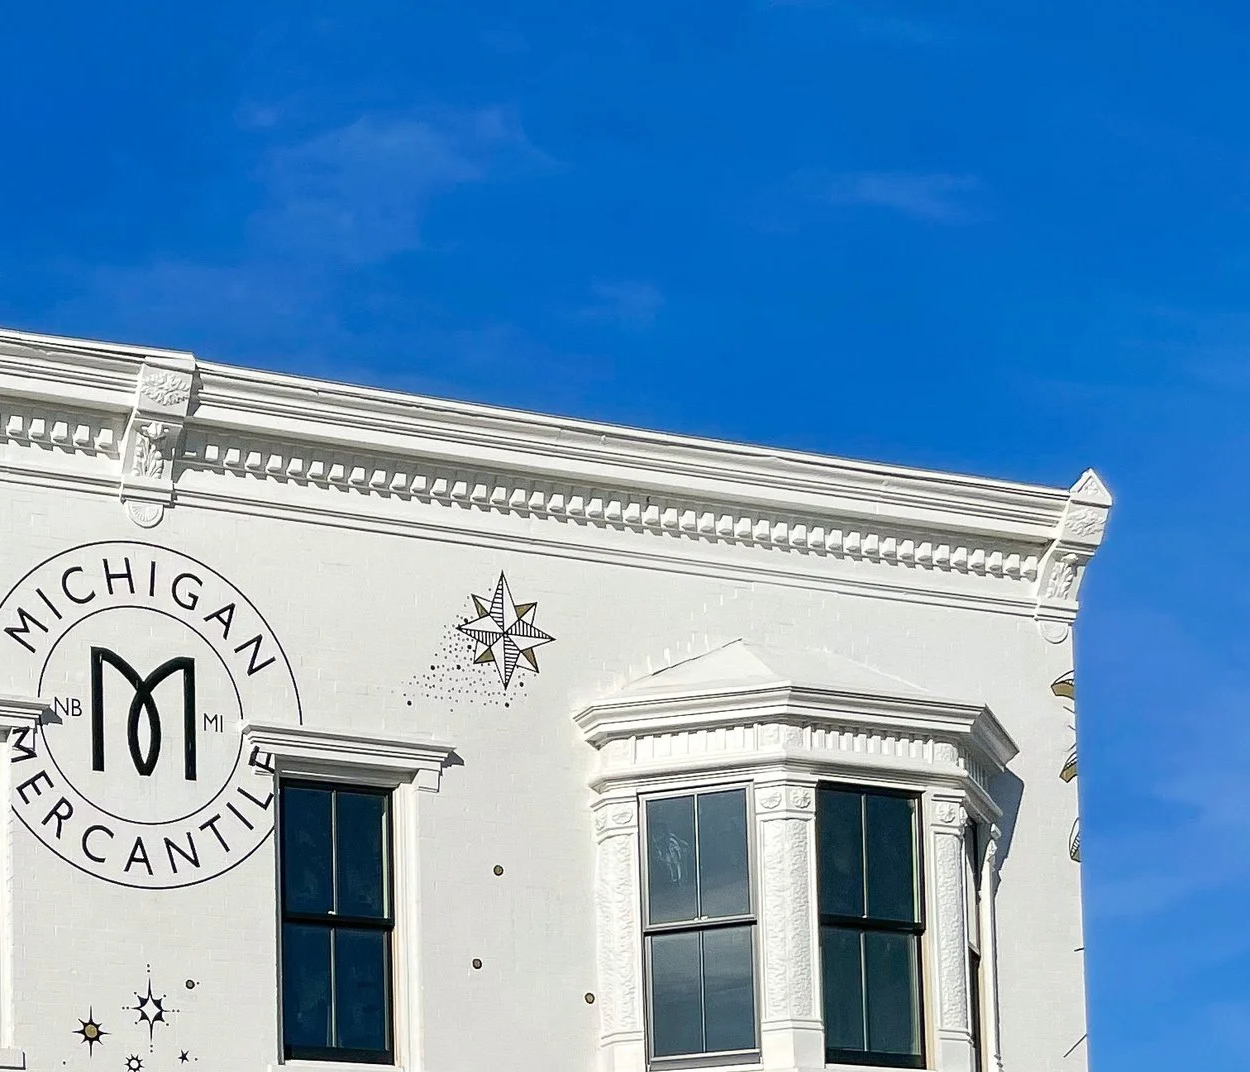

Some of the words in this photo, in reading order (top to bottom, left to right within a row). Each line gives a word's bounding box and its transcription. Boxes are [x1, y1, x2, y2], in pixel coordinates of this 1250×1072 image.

[4, 557, 276, 676] MICHIGAN
[54, 696, 82, 717] NB
[203, 712, 223, 733] MI
